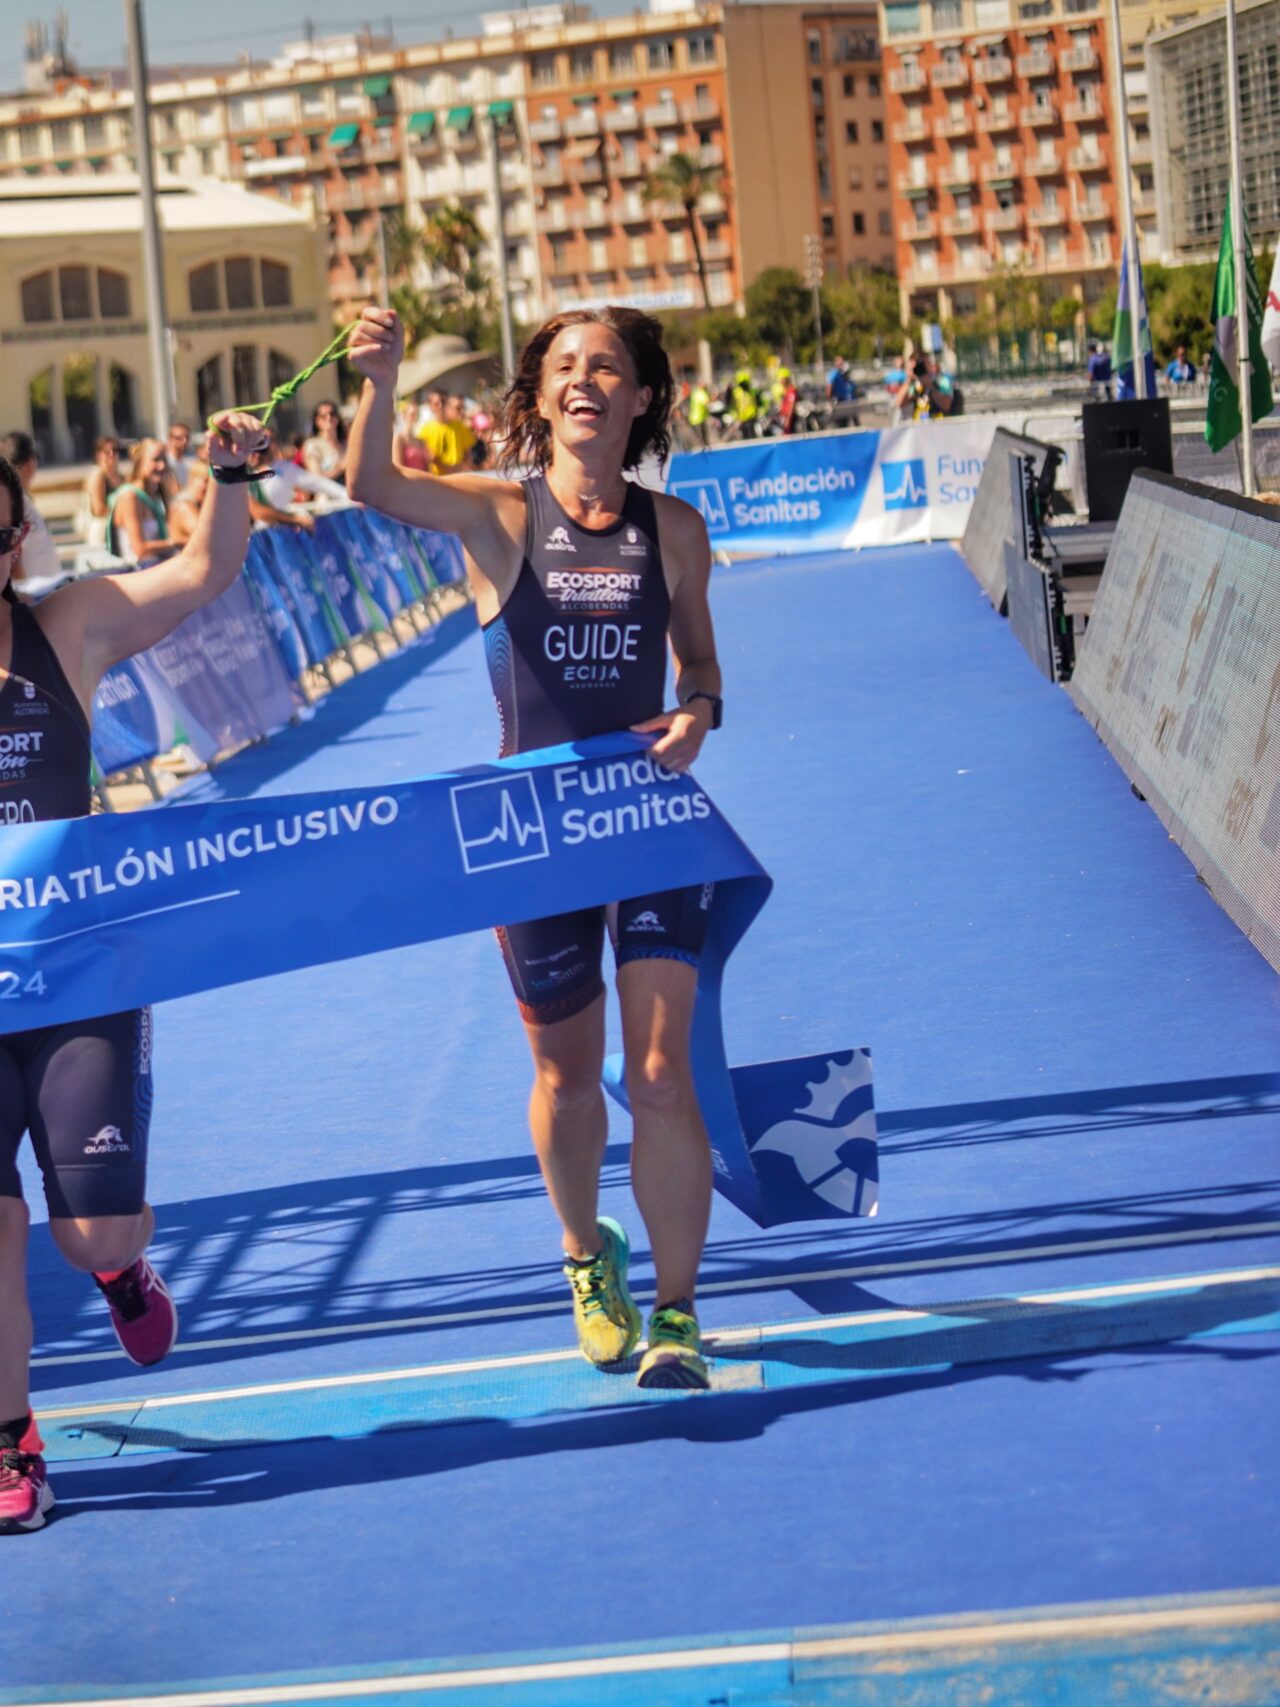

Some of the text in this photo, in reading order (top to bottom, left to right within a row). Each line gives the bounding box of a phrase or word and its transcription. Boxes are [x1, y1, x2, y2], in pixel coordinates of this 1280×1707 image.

[938, 454, 987, 477] Fun
[729, 466, 856, 501] Fundación
[734, 498, 821, 527] Sanitas
[546, 571, 641, 590] ECOSPORT
[561, 602, 630, 611] ALCOBENDAS
[544, 624, 641, 661] GUIDE
[564, 665, 621, 681] ECIJA
[553, 753, 692, 802] Funda
[185, 795, 399, 871] INCLUSIVO
[562, 791, 711, 845] Sanitas
